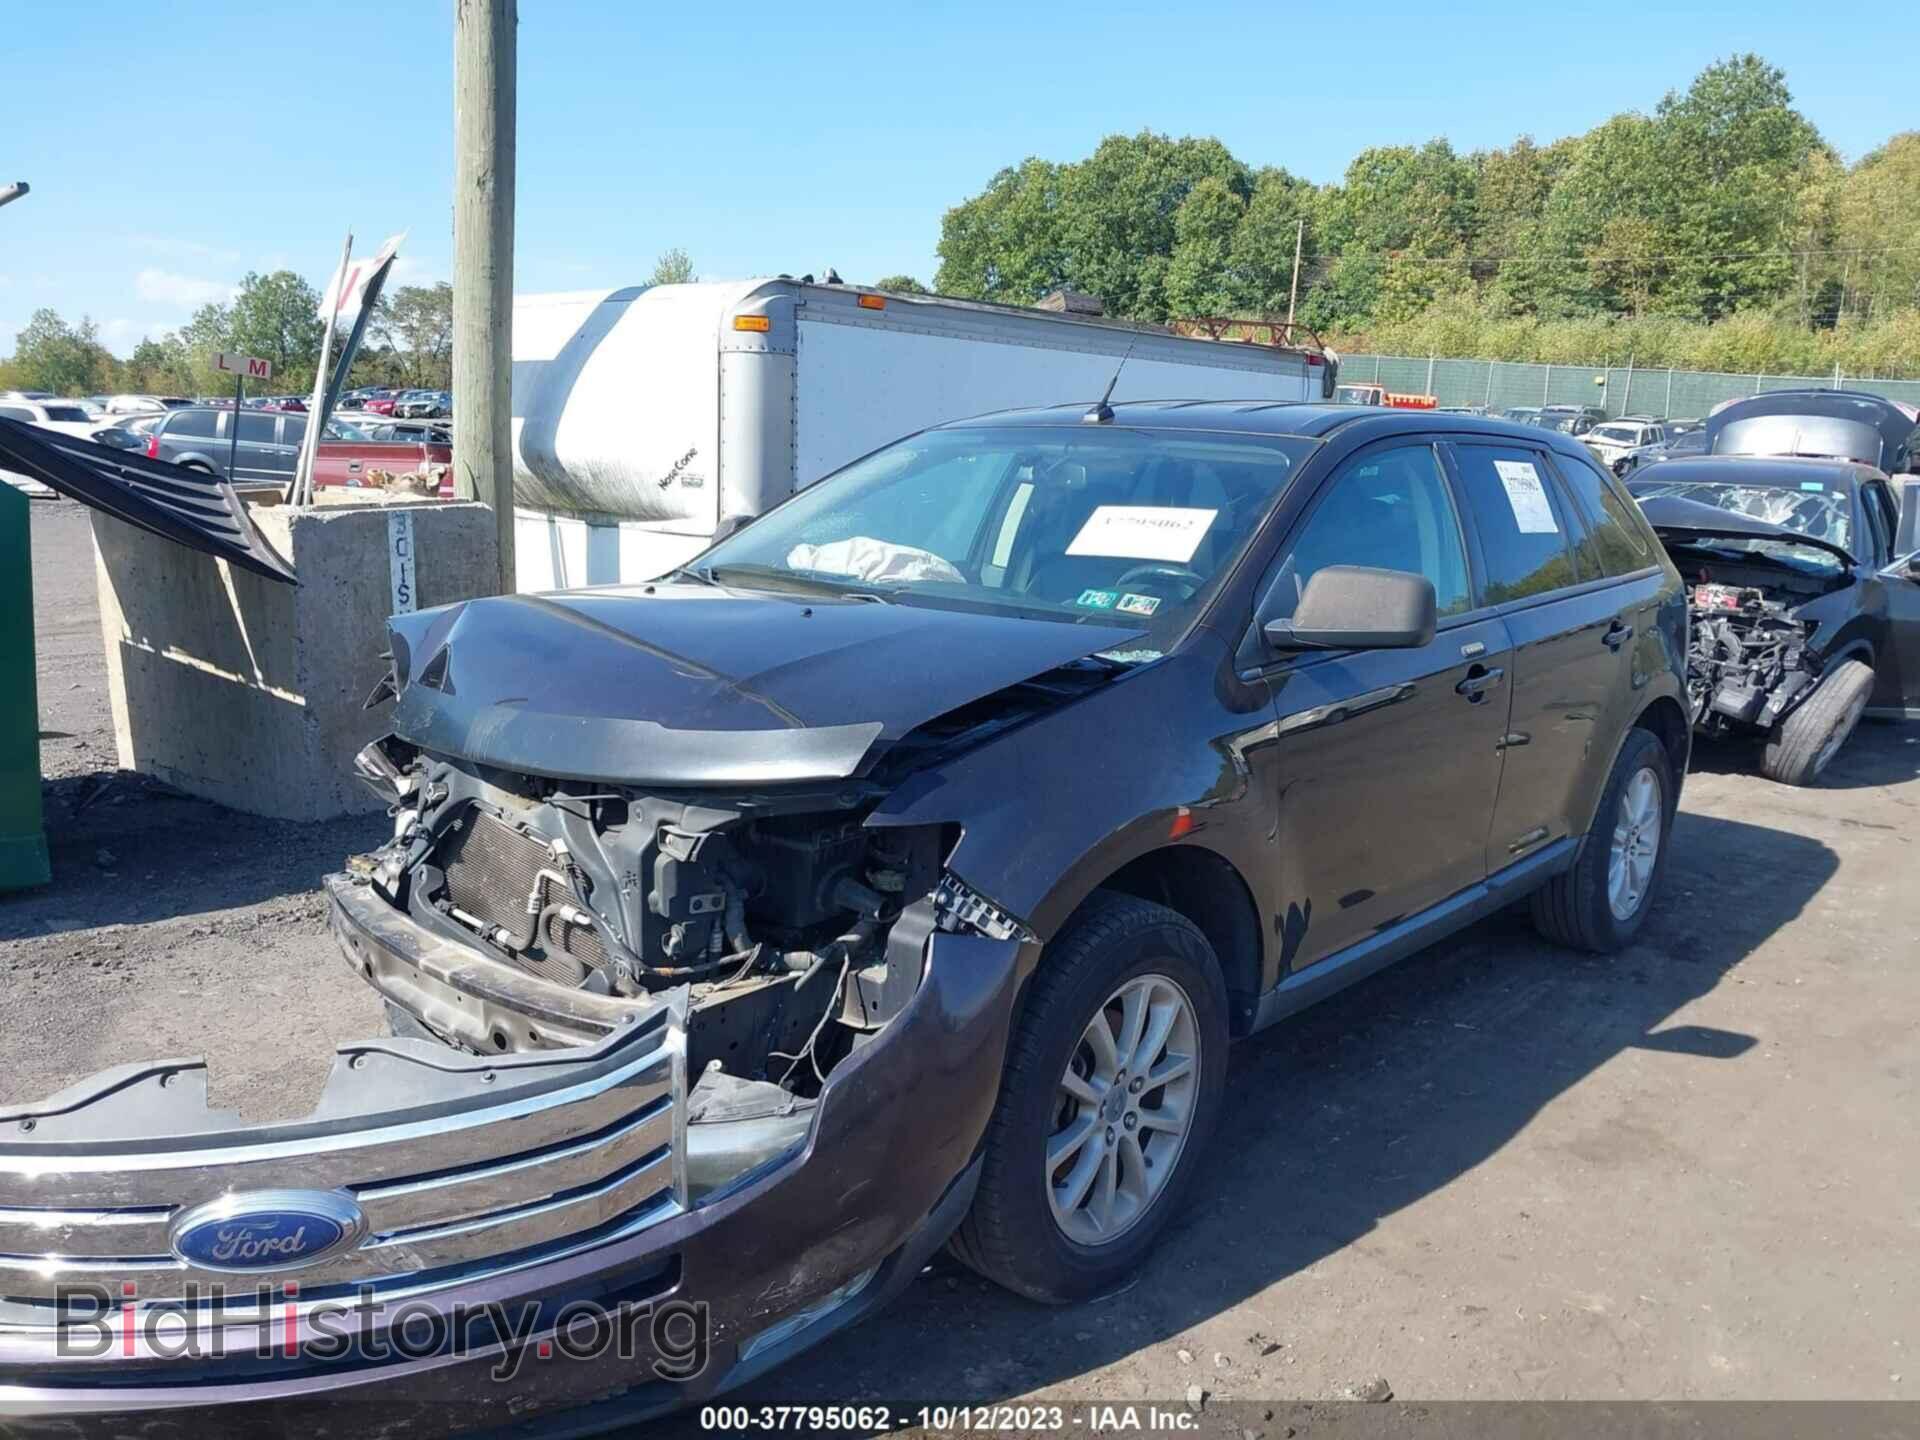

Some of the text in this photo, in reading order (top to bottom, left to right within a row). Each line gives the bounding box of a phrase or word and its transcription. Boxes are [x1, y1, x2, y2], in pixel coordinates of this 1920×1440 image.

[219, 354, 267, 376] L M
[212, 1224, 307, 1260] Ford
